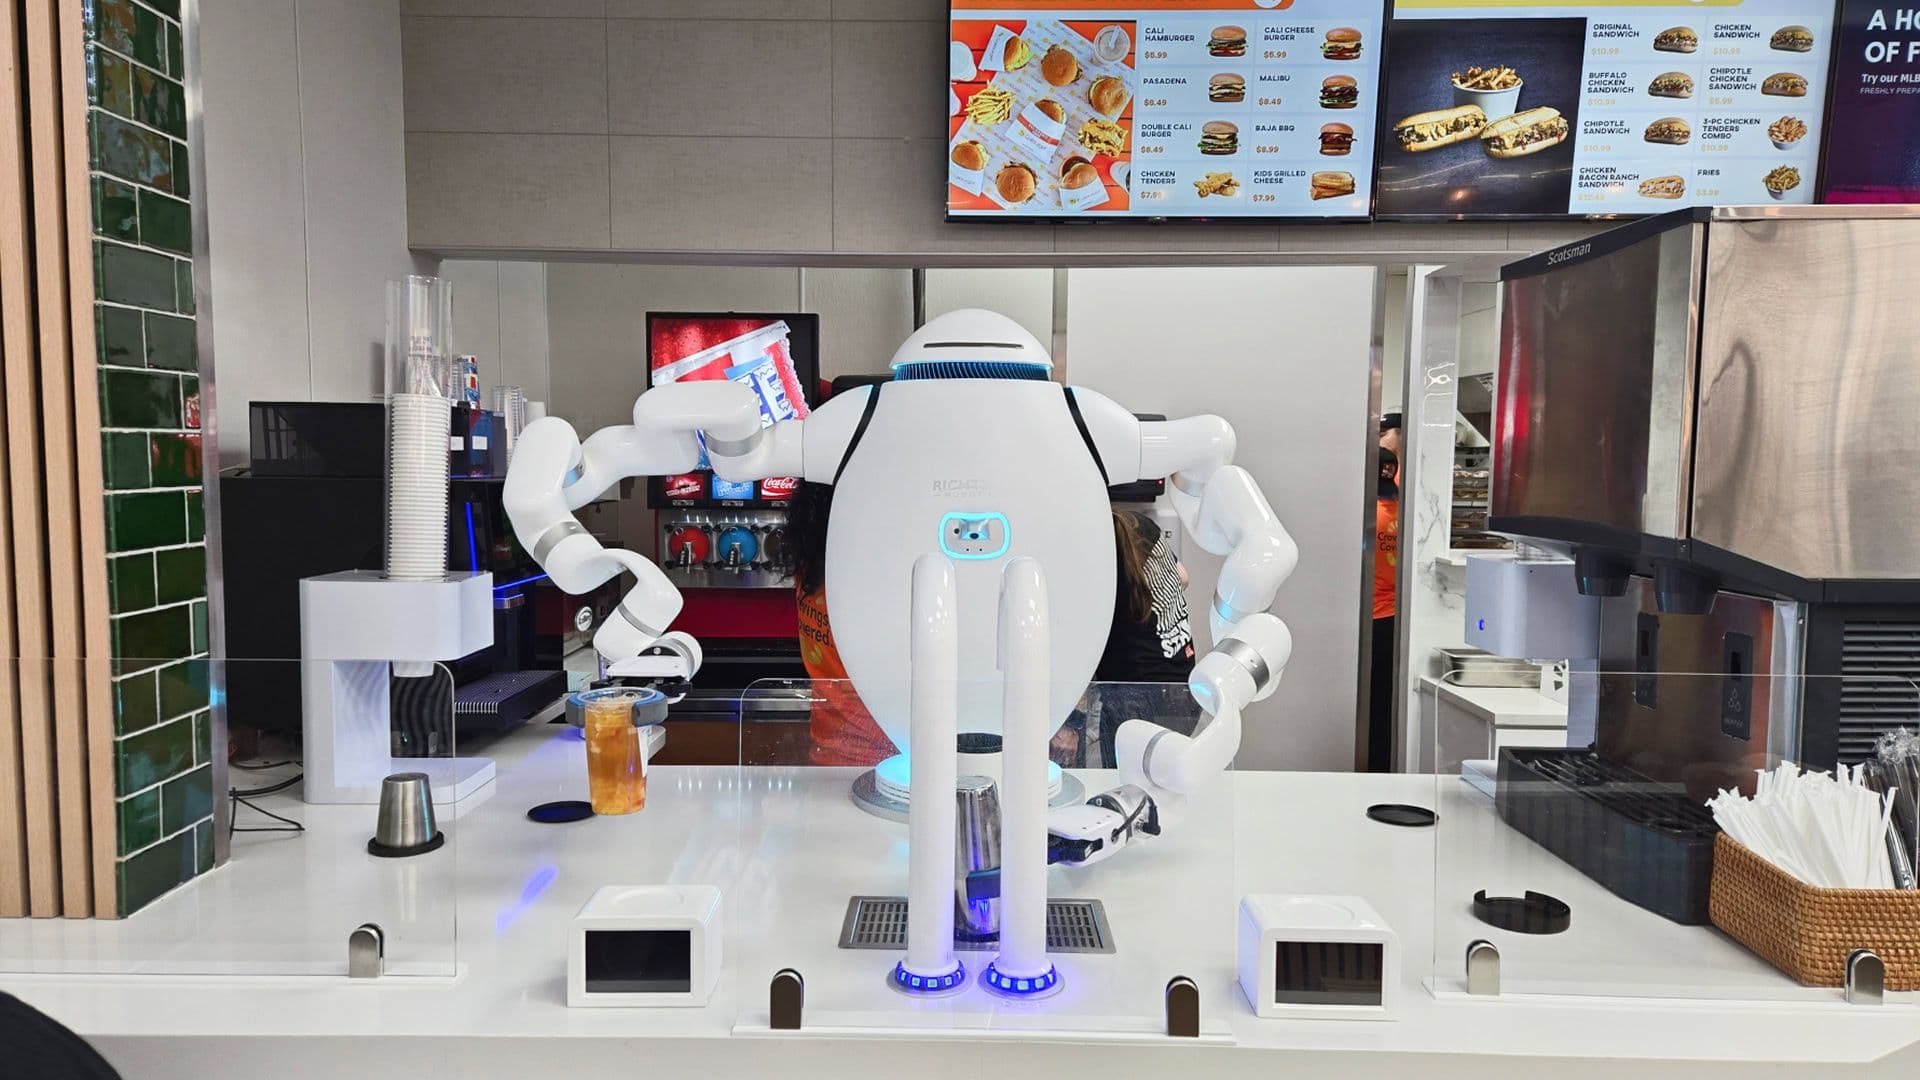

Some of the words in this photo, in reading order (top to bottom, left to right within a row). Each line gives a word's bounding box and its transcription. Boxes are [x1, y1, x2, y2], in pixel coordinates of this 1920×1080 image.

[1866, 8, 1888, 31] A
[1284, 26, 1315, 34] CHEESE
[1593, 23, 1632, 31] ORIGINAL
[1864, 41, 1901, 63] OF
[1710, 67, 1752, 75] CHIPOTLE
[1861, 73, 1879, 85] Try
[1880, 74, 1898, 83] our
[1587, 86, 1634, 94] SANDWICH
[1859, 87, 1895, 95] FRESHLY
[1583, 127, 1630, 135] SANDWICH
[1701, 132, 1732, 140] COMBO
[1609, 173, 1640, 181] RANCH
[1547, 242, 1591, 266] Scotsman
